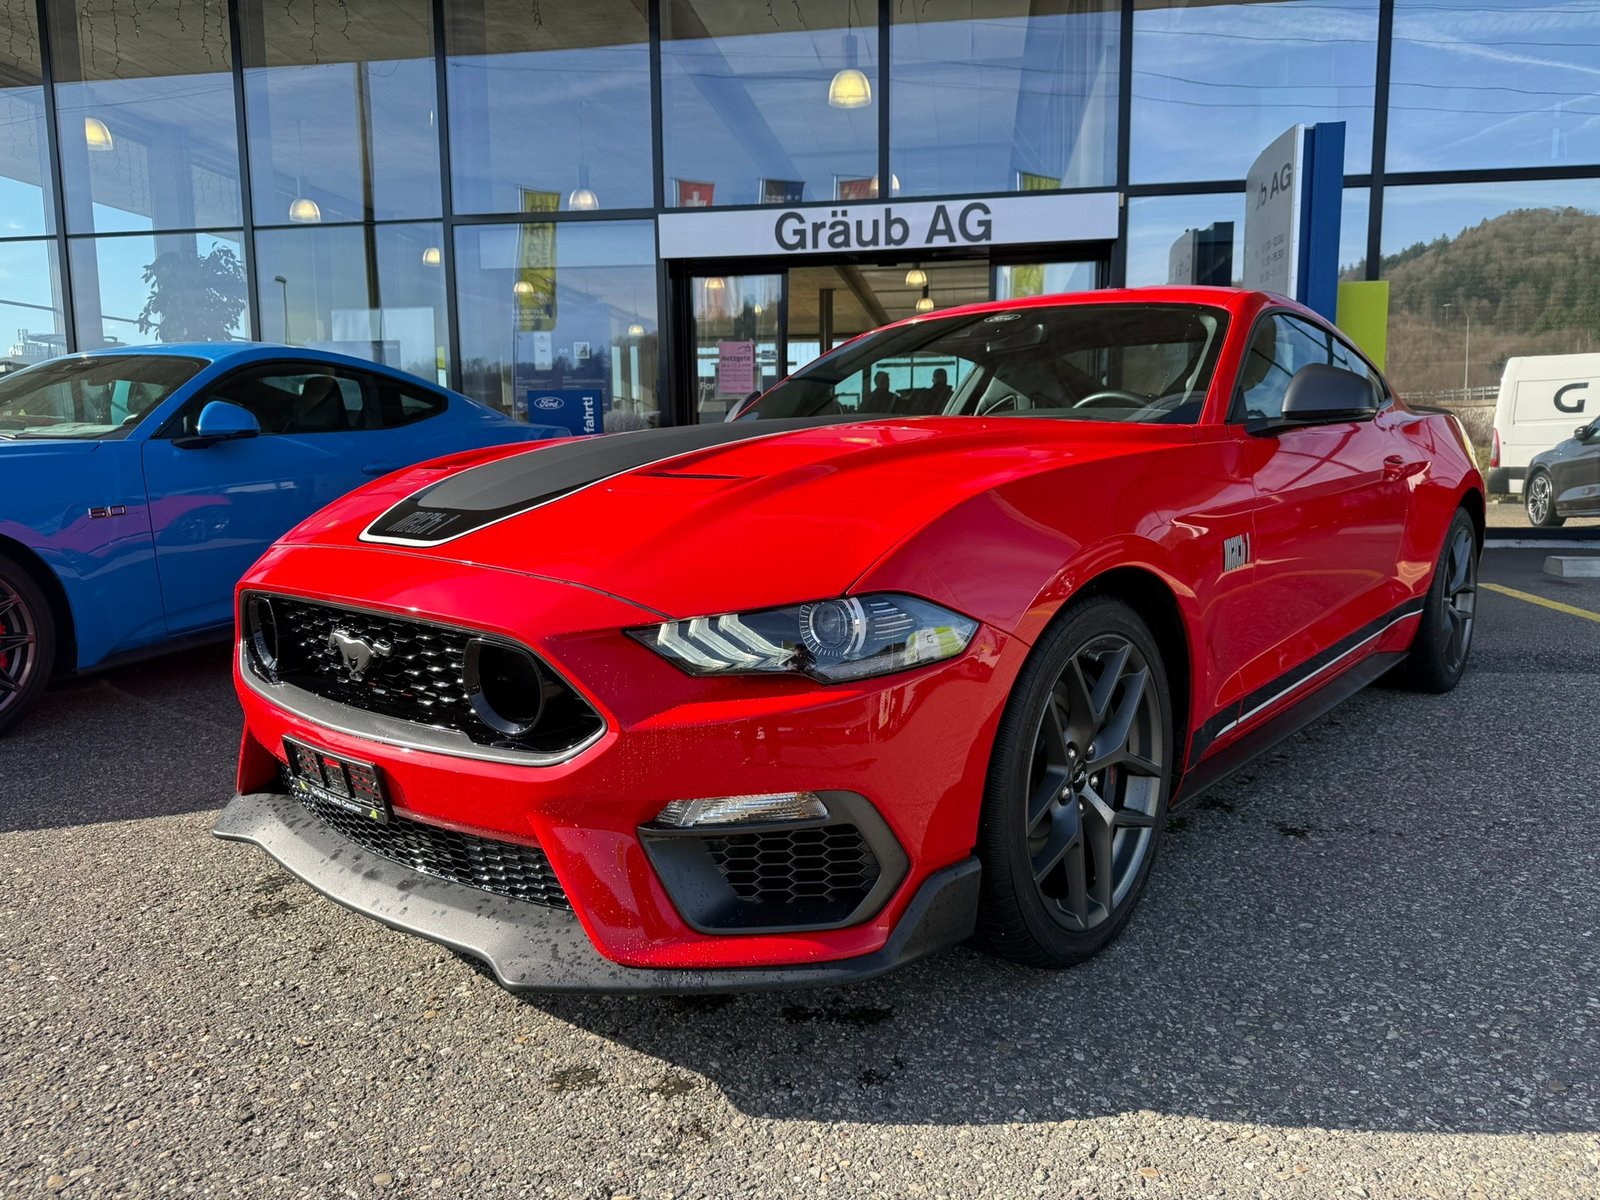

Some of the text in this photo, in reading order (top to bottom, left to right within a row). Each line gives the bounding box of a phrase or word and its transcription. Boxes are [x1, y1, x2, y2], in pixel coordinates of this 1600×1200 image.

[1270, 163, 1292, 200] AG
[774, 202, 992, 252] Gräub AG
[1553, 382, 1589, 413] G
[341, 800, 362, 813] Center
